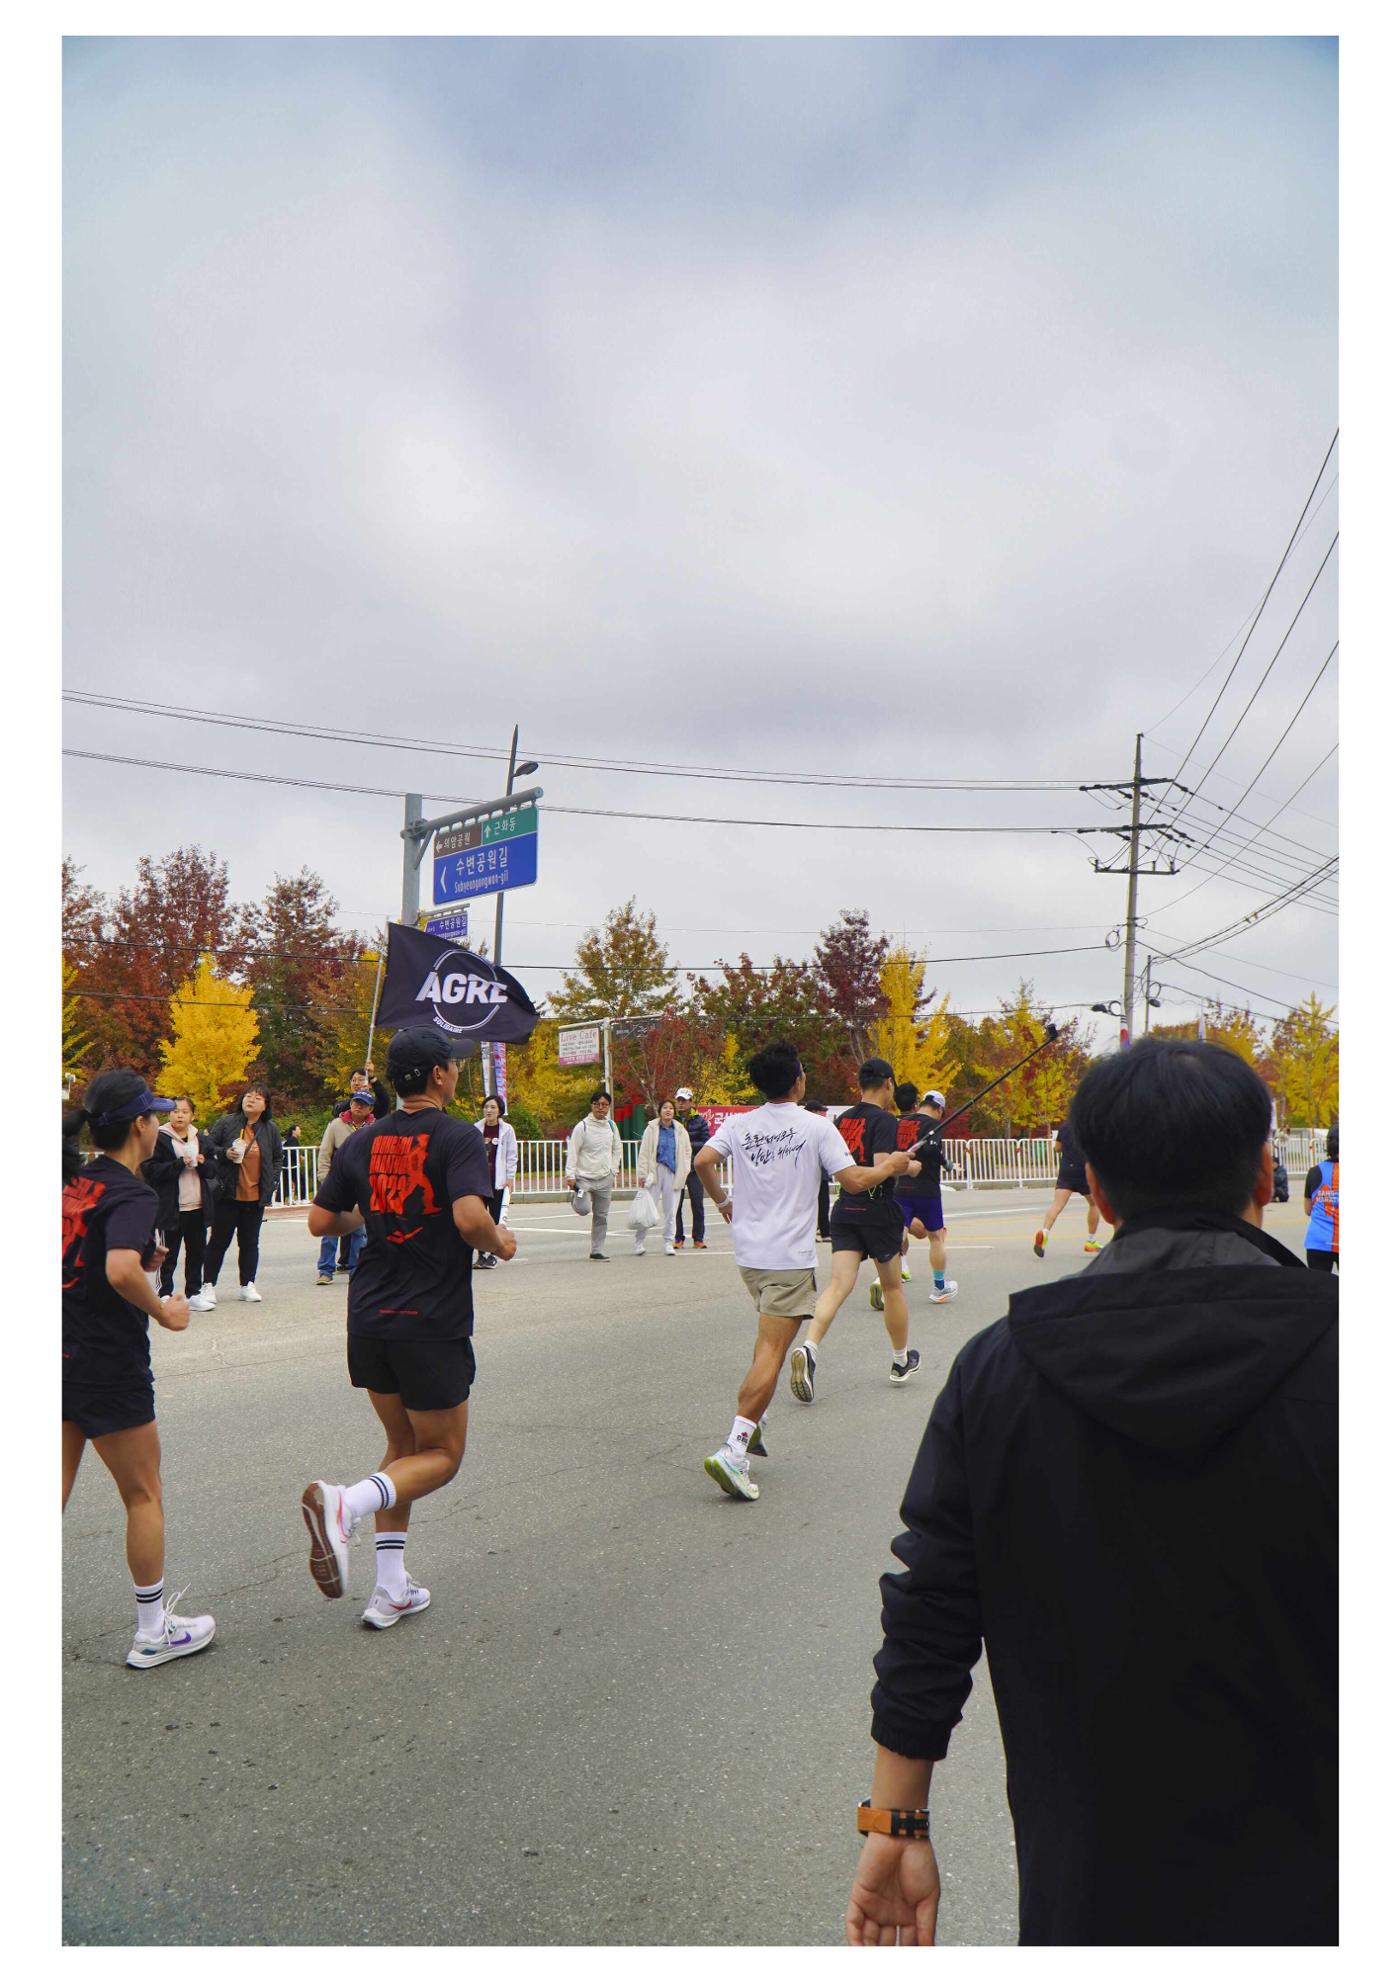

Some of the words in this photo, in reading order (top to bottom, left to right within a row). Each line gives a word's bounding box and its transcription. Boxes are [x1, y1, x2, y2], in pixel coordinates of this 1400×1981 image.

[494, 817, 516, 835] 근화동
[444, 832, 470, 848] 의암공원
[456, 846, 508, 876] 수변공원길
[440, 915, 466, 931] 수변공원길
[415, 971, 508, 1004] AGRE
